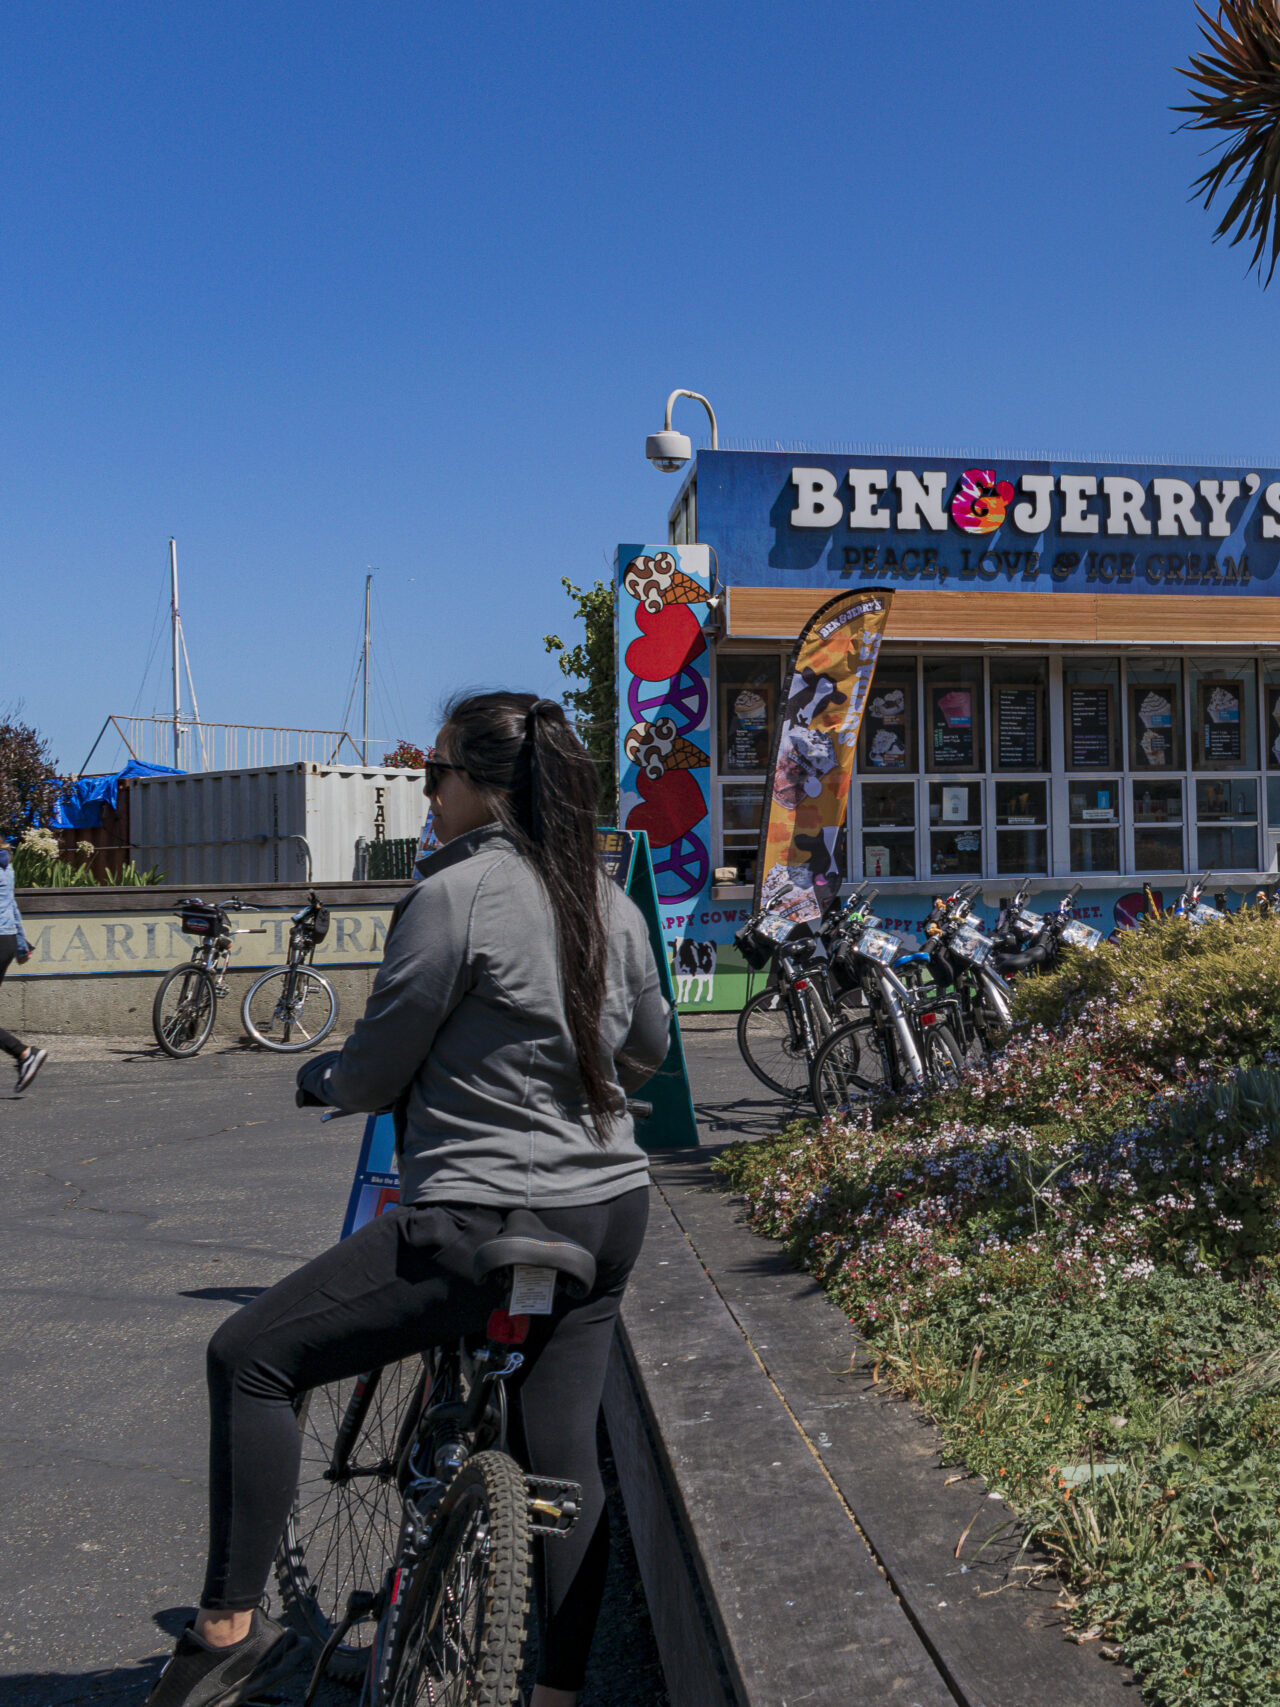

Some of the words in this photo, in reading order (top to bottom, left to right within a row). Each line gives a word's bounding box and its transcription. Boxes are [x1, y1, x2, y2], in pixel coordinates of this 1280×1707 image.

[841, 547, 949, 583] PEACE,
[959, 549, 1041, 578] LOVE
[1052, 551, 1081, 578] &
[1088, 552, 1137, 579] ICE
[1145, 553, 1251, 582] CREAM
[661, 914, 696, 930] PPY
[877, 917, 913, 933] APPY
[260, 914, 391, 957] TR
